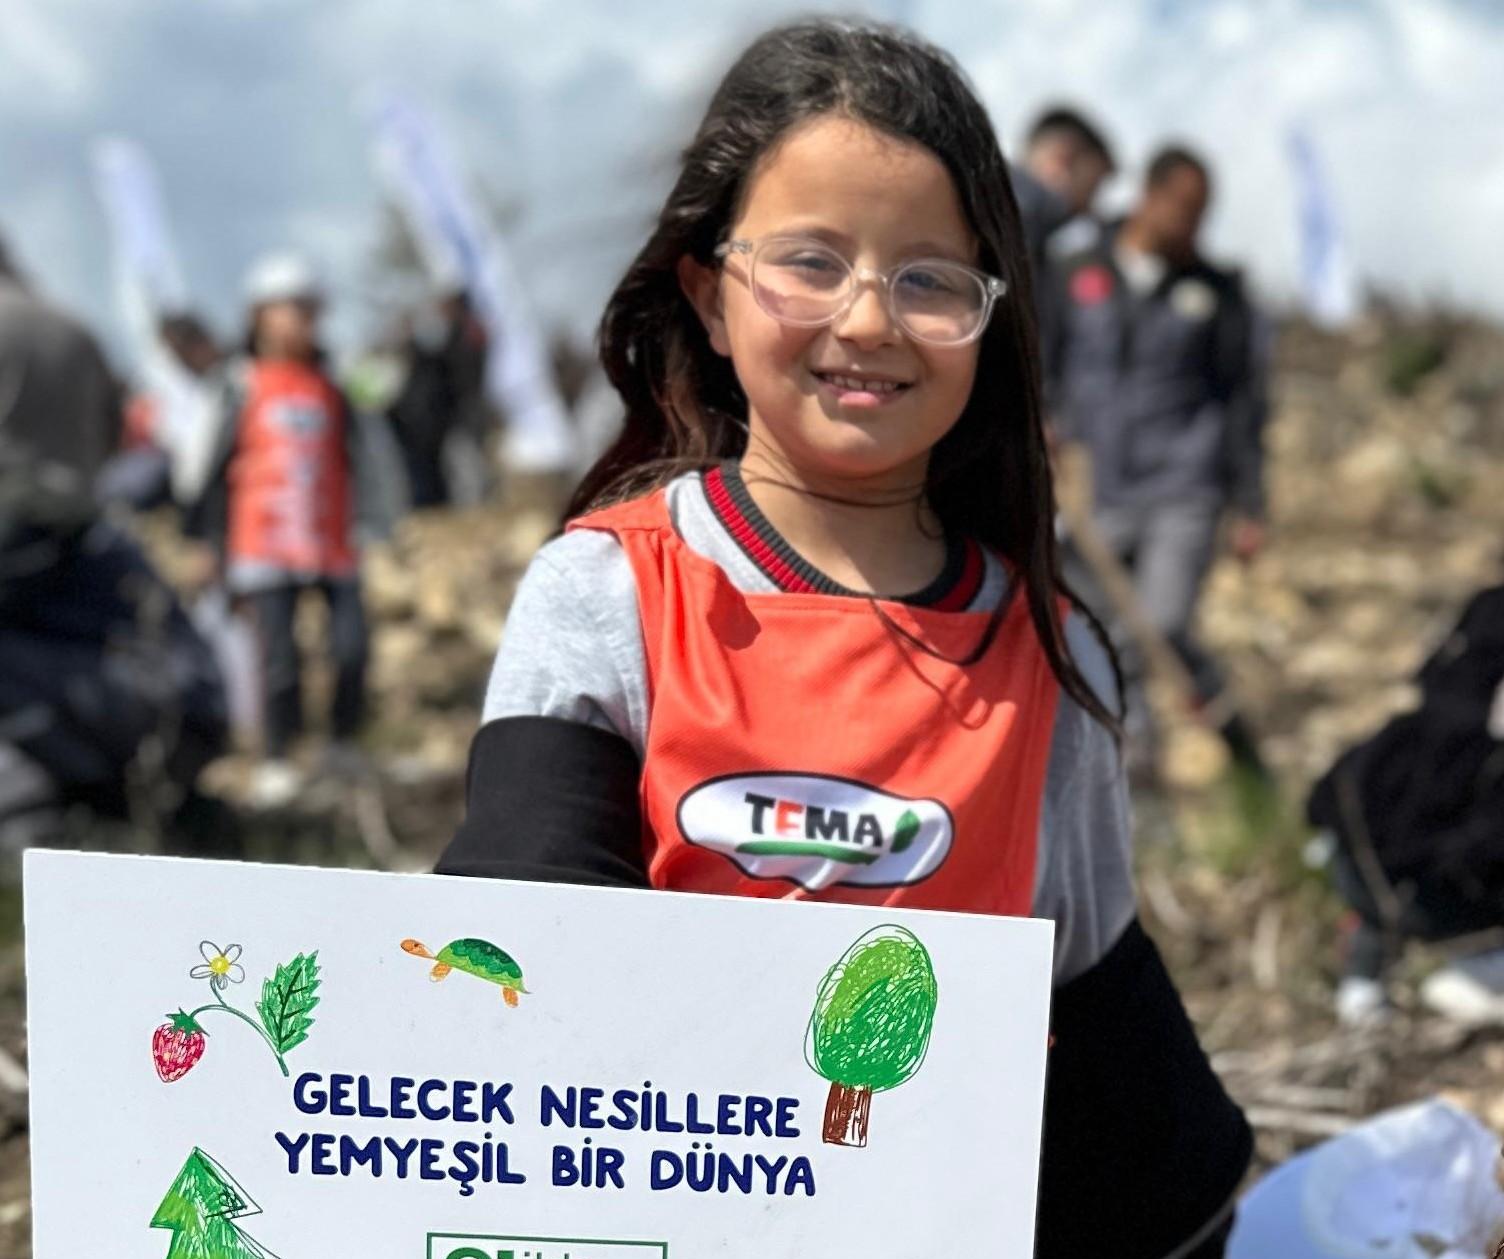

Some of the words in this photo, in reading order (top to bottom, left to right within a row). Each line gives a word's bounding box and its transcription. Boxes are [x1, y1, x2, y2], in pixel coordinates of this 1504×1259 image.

[744, 792, 884, 848] TEMA
[293, 1072, 515, 1125] GELECEK
[540, 1080, 801, 1138] NESİLLERE
[274, 1131, 527, 1197] YEMYEŞİL
[552, 1136, 625, 1189] BİR
[650, 1141, 816, 1197] DÜNYA
